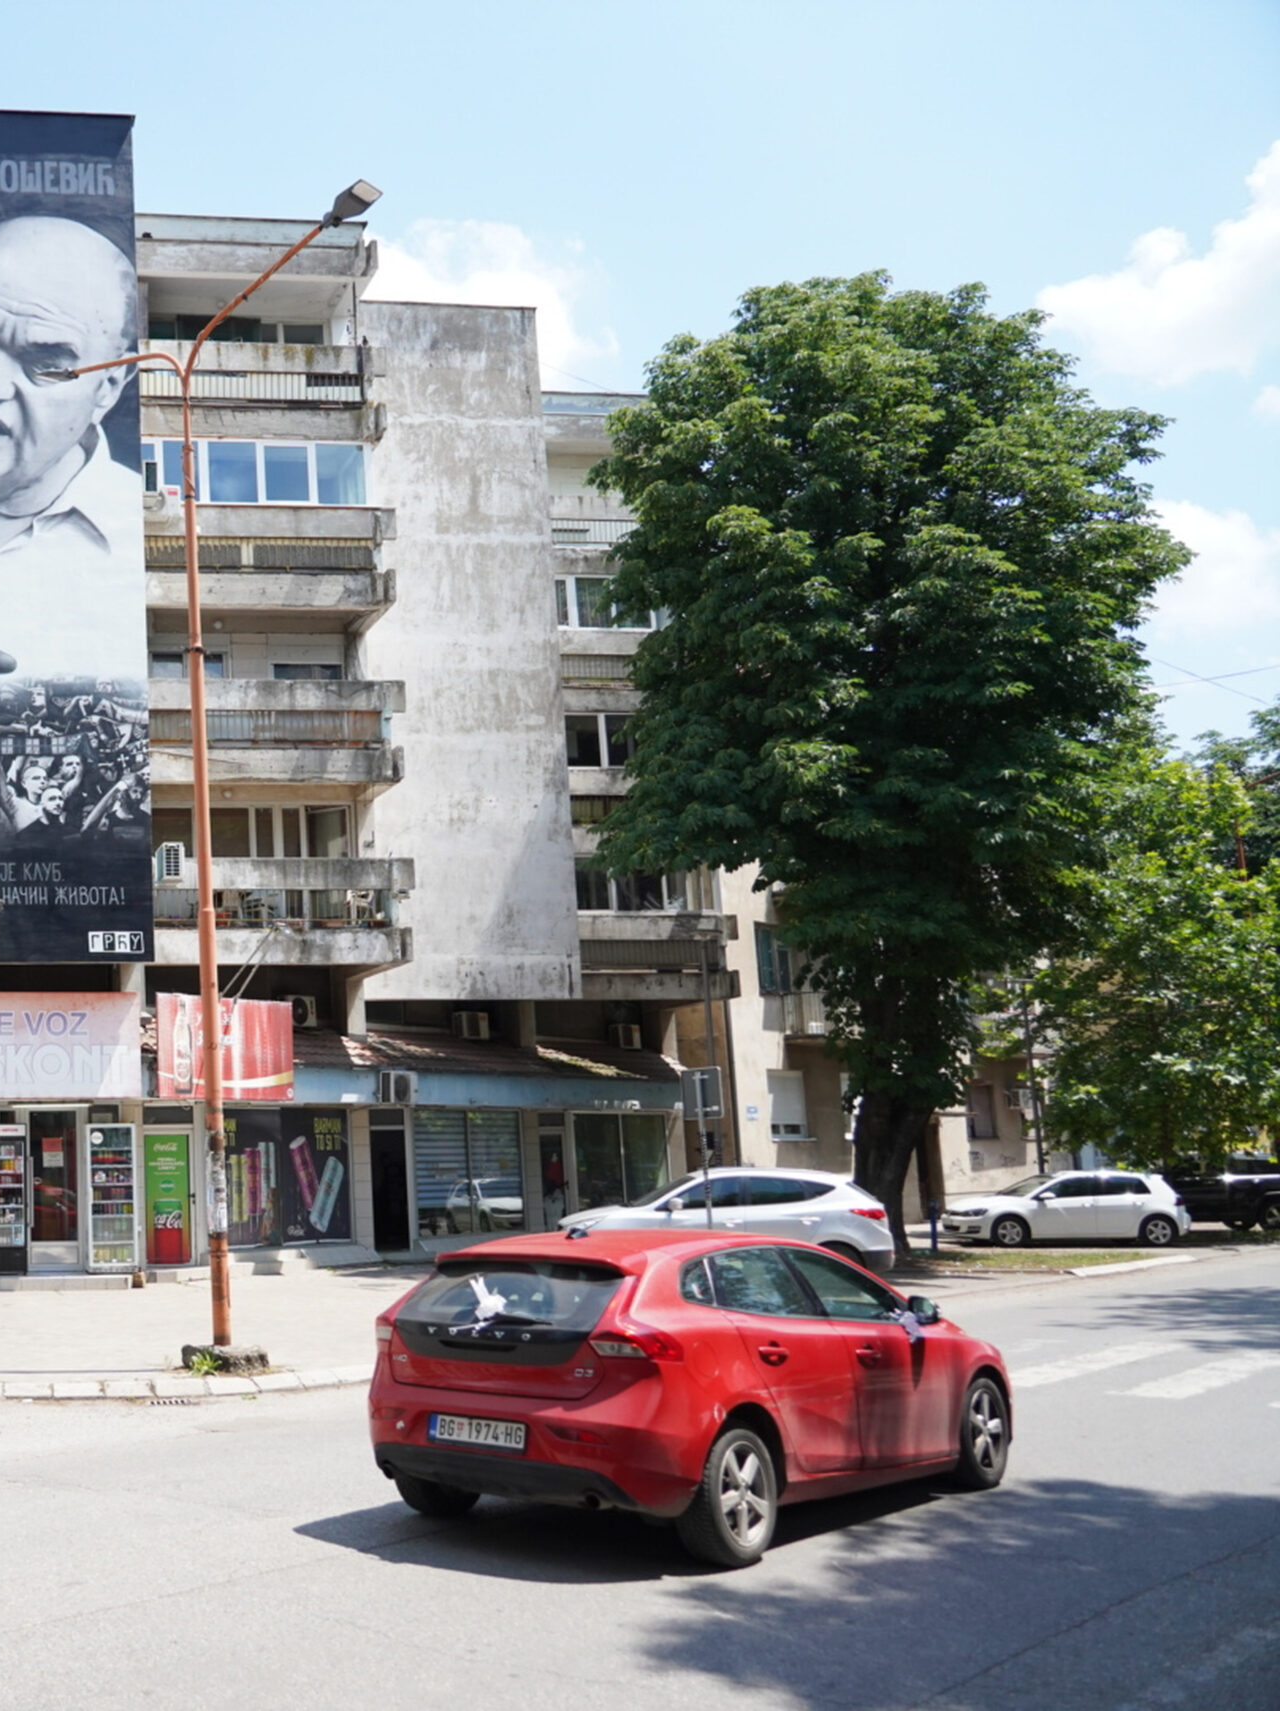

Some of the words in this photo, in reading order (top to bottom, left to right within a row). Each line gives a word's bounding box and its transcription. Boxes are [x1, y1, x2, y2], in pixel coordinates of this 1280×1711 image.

[23, 862, 65, 882] КЛУБ.
[2, 886, 49, 905] НАЧИН
[54, 886, 126, 905] ЖИВОТА!
[24, 1012, 88, 1036] VOZ
[439, 1418, 455, 1437] BG
